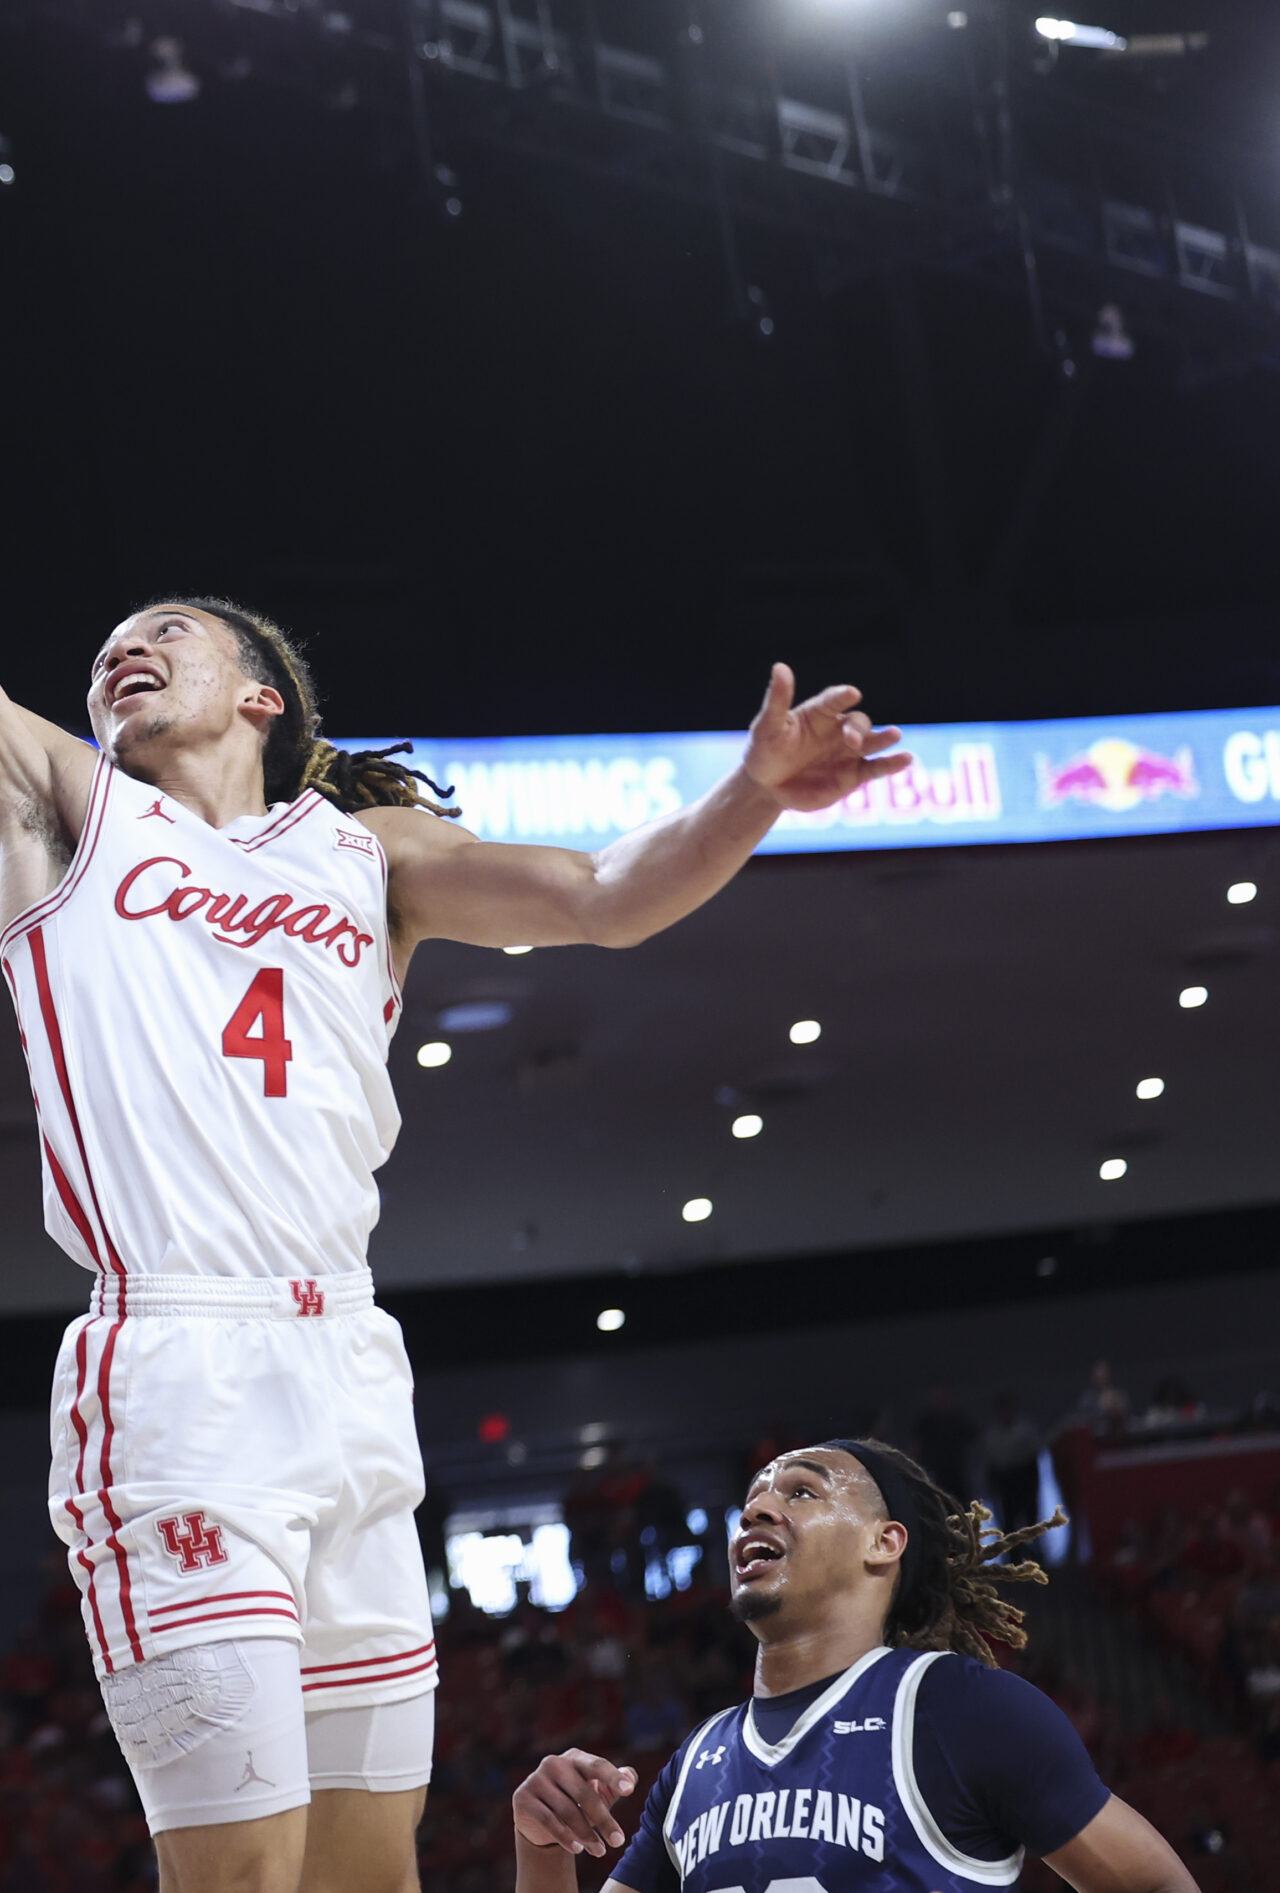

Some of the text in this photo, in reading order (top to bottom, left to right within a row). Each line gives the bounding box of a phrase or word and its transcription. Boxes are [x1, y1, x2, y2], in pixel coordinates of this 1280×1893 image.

[445, 757, 682, 836] WINGS
[115, 856, 374, 967] Cougars
[222, 968, 292, 1098] 4
[729, 1788, 885, 1863] ORLEANS
